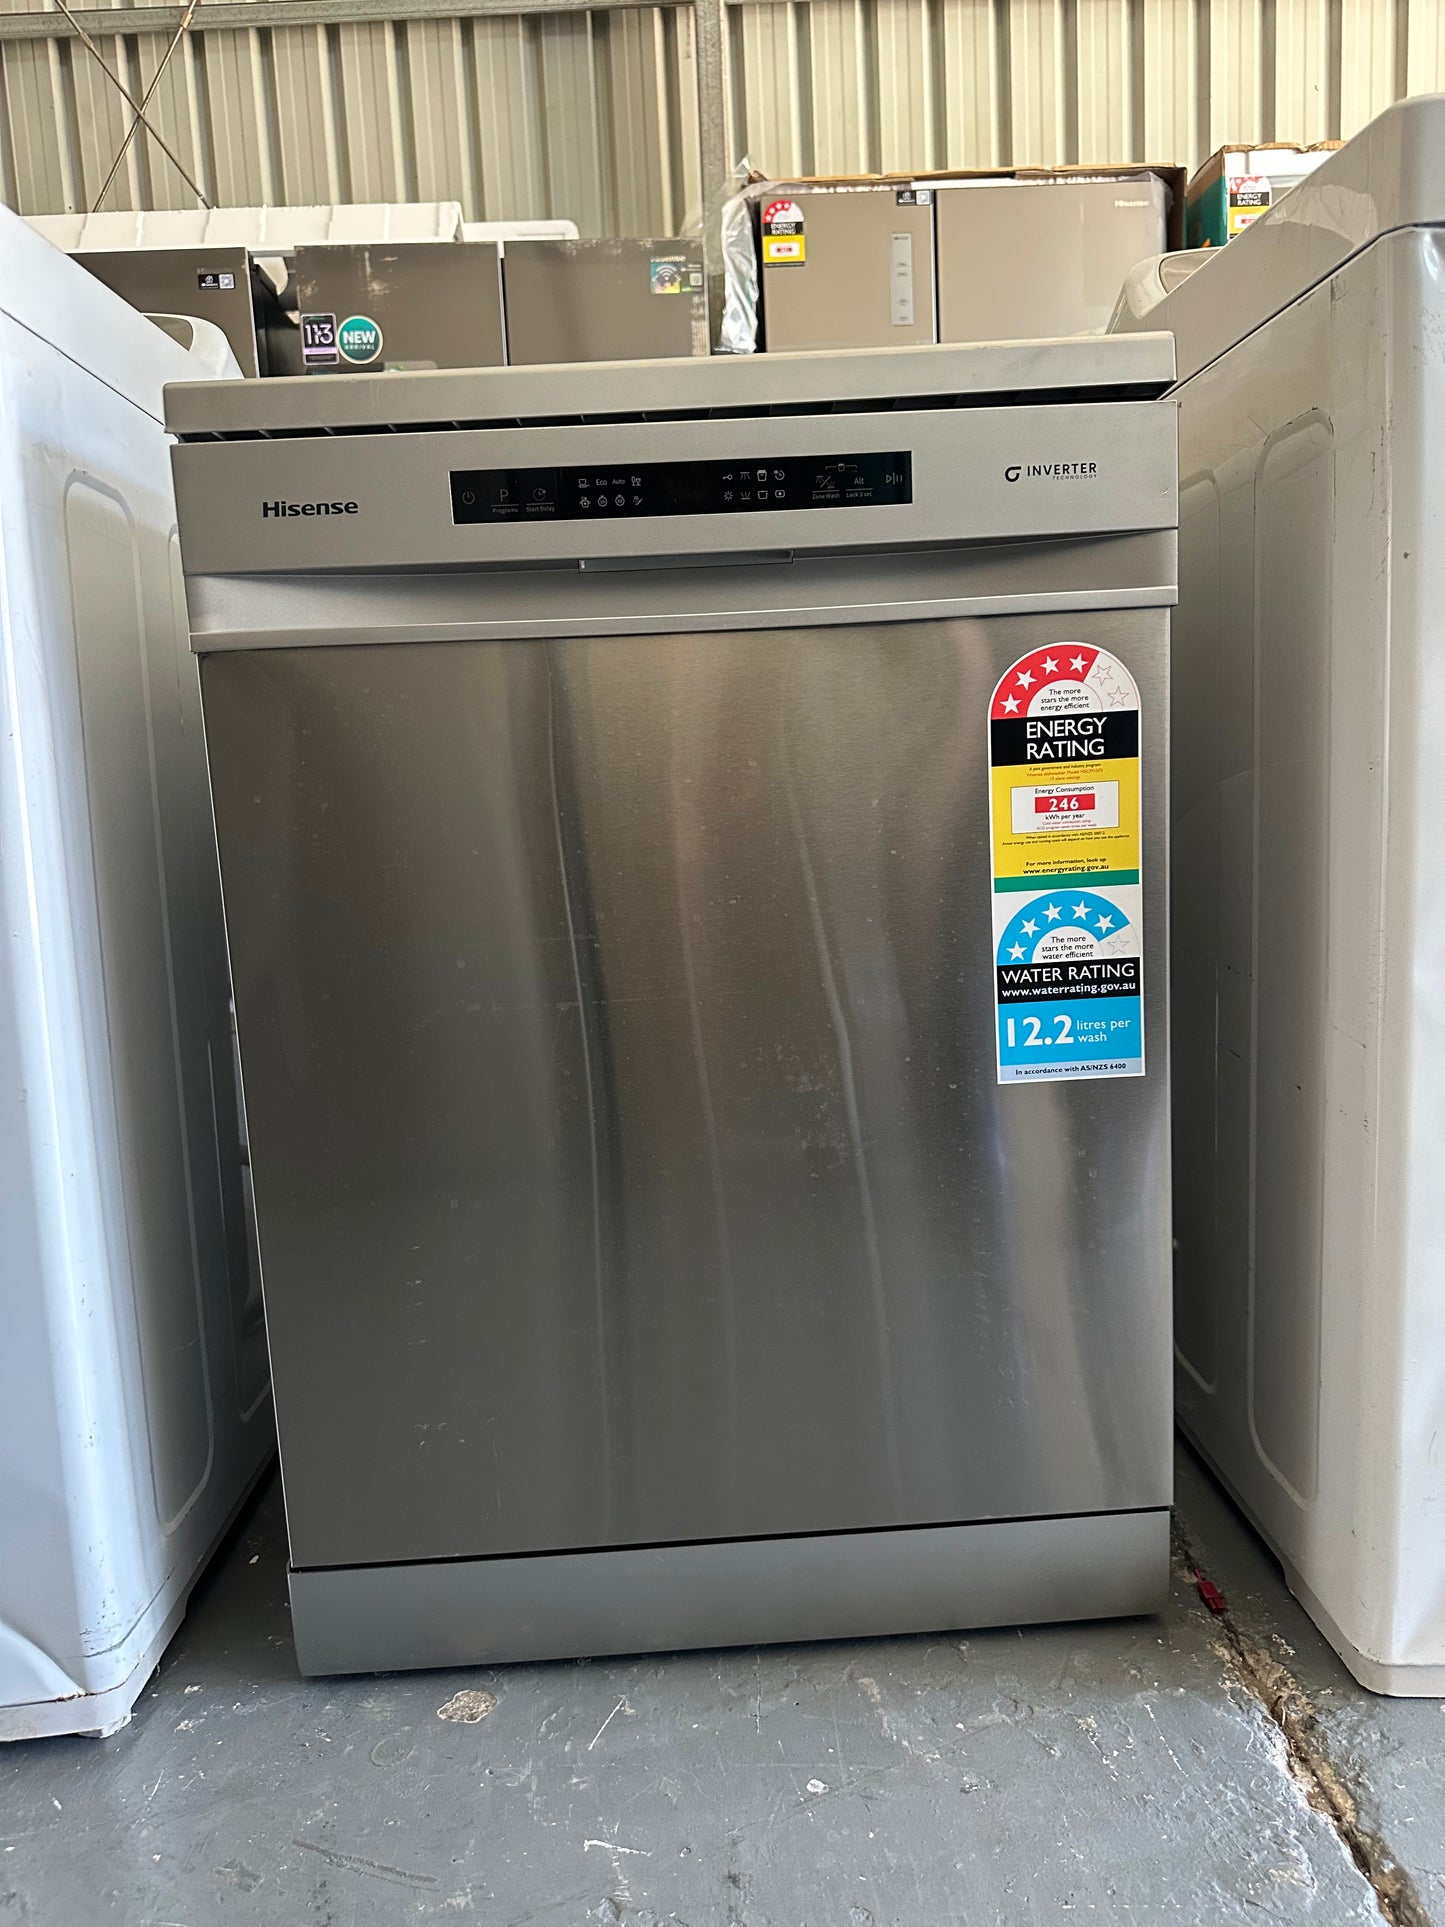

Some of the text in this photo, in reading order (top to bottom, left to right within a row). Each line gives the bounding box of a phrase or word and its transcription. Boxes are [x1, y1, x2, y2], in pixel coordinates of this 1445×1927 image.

[342, 330, 376, 344] NEW
[1027, 462, 1097, 476] INVERTER
[499, 489, 509, 502] P
[262, 501, 359, 518] Hisense
[1026, 717, 1108, 738] ENERGY
[1026, 738, 1105, 760] RATING
[1049, 797, 1079, 811] 246
[1023, 865, 1109, 874] www.energyrating.gov.au
[1002, 963, 1135, 984] WATER RATING
[1002, 982, 1136, 997] www.waterrating.gov.au
[1007, 1014, 1130, 1048] 12.2 litres per
[1078, 1032, 1107, 1042] wash
